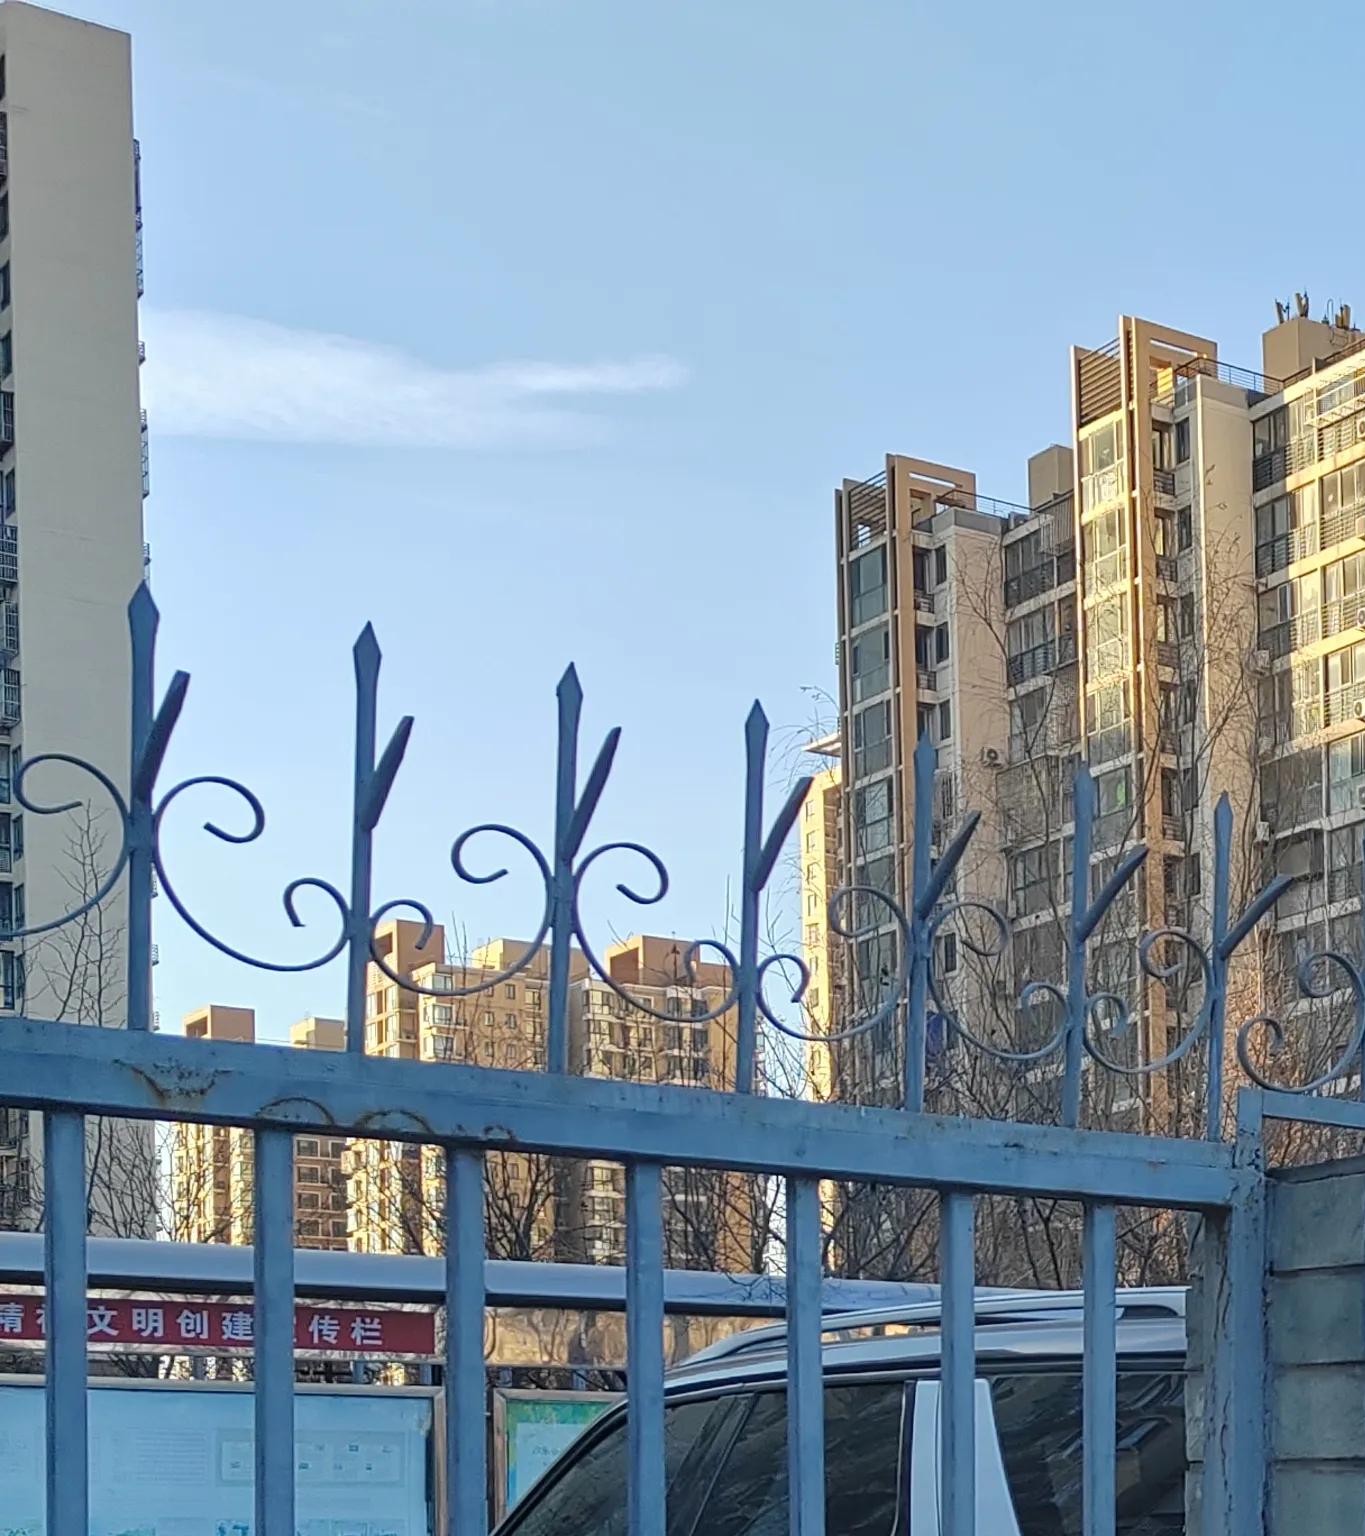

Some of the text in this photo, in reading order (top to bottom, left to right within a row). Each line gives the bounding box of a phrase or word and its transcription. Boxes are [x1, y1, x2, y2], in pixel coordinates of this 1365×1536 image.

[0, 1302, 383, 1346] 精文明创建传栏
